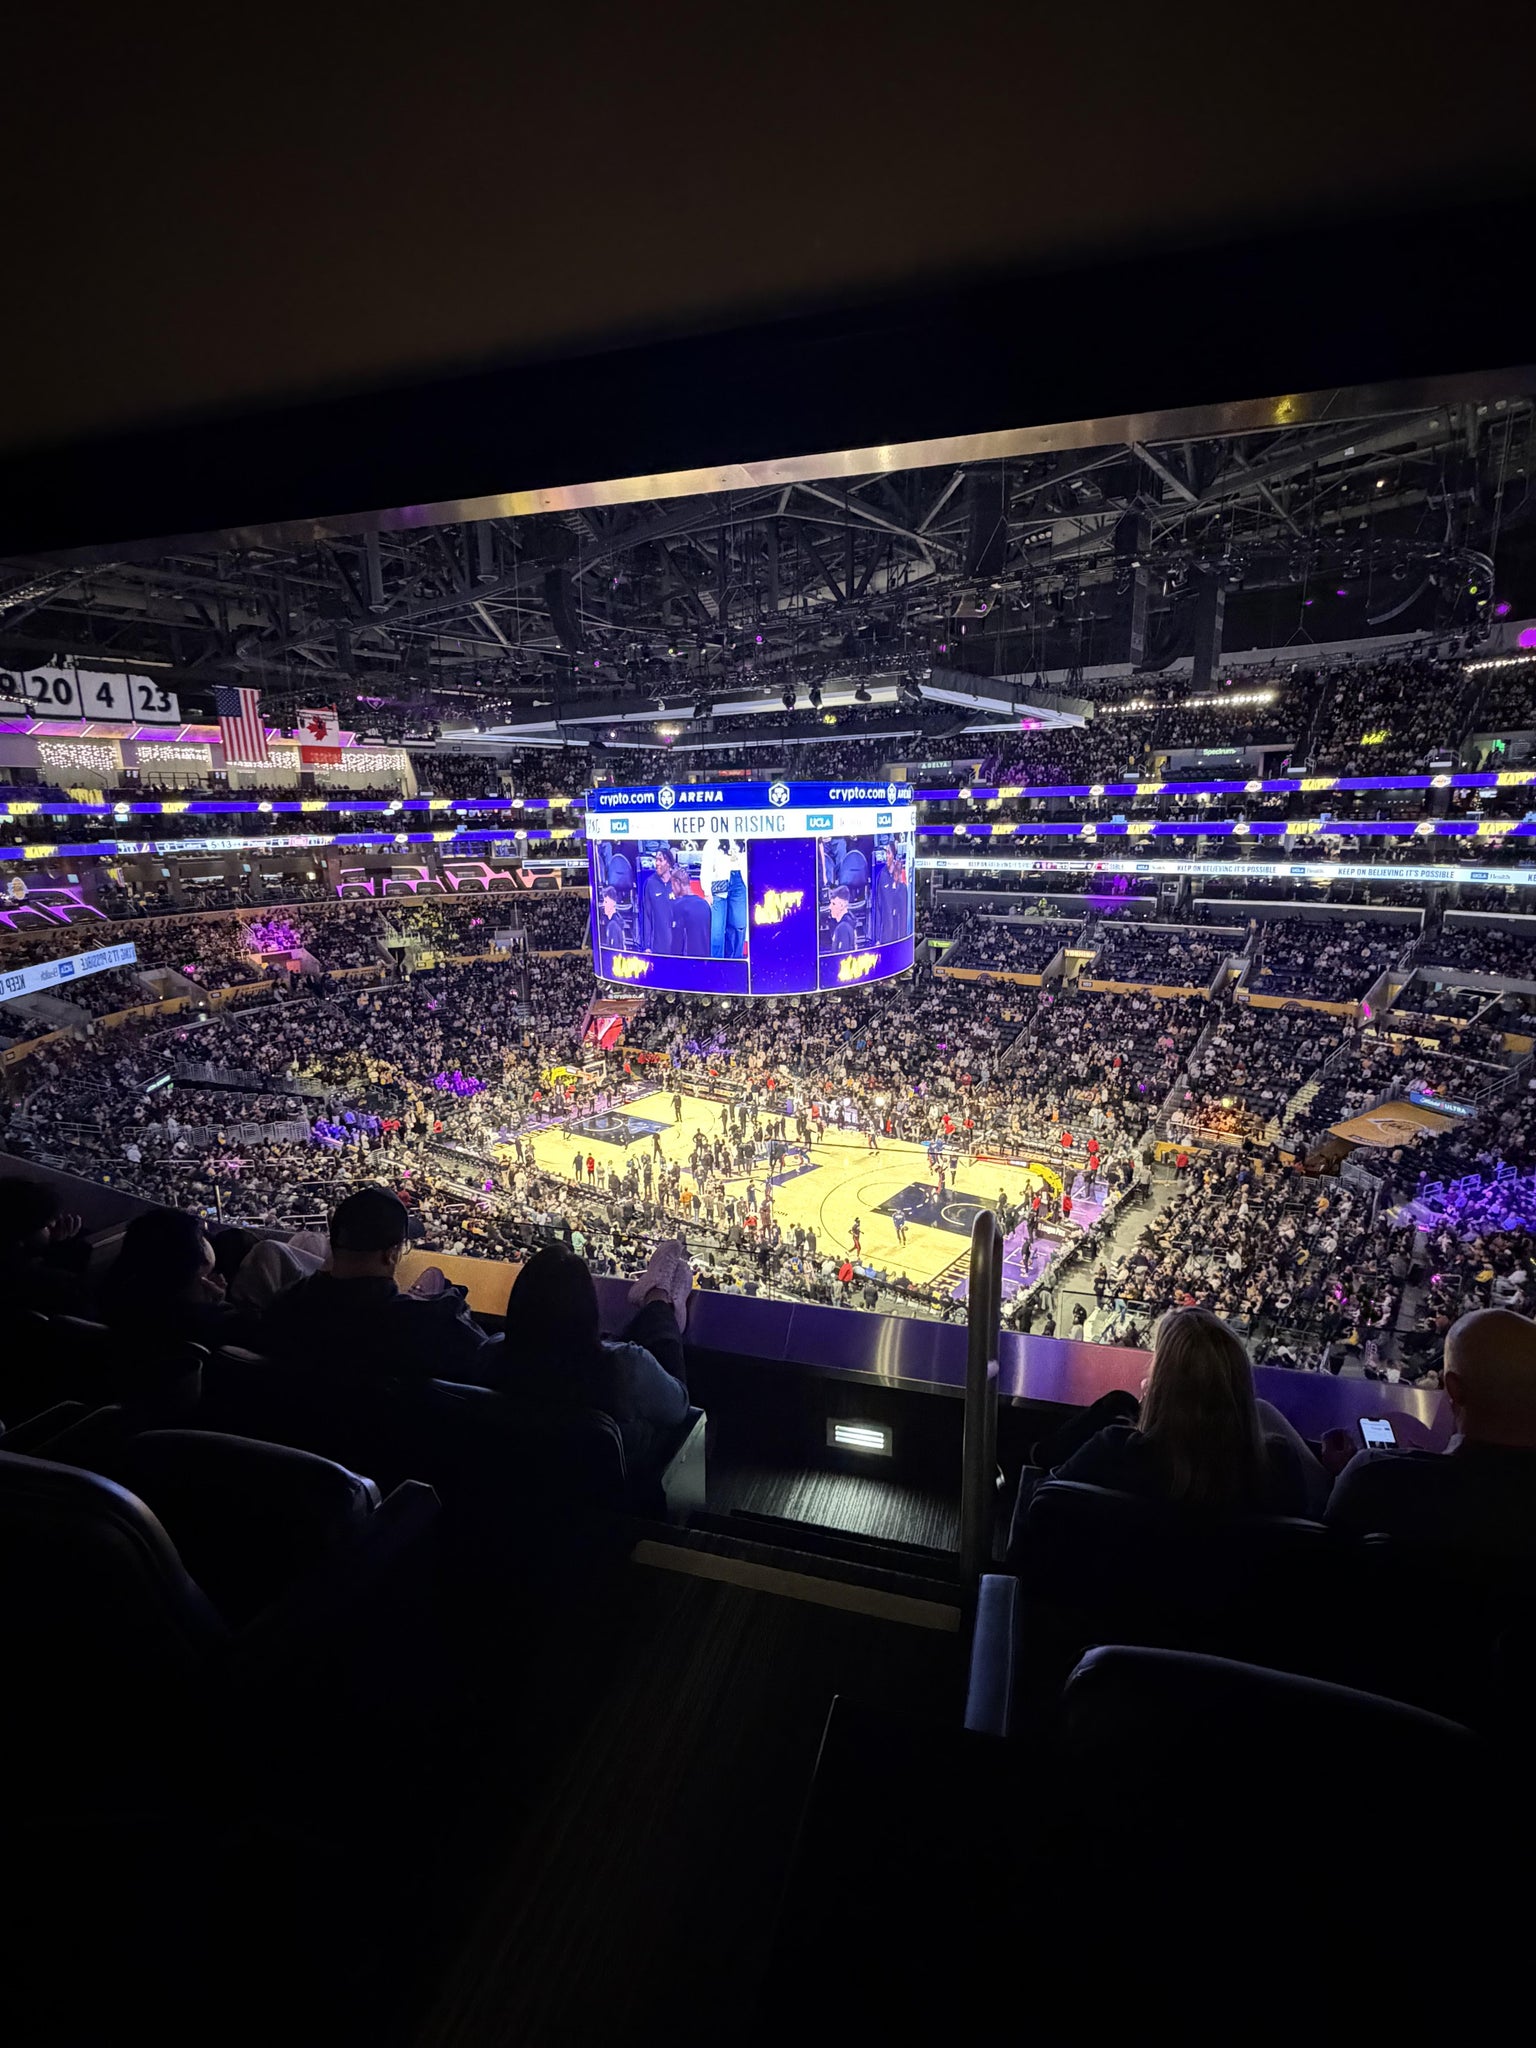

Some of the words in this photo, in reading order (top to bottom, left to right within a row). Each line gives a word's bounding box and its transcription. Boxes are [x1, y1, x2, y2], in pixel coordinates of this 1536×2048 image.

[32, 676, 73, 705] 20
[96, 682, 114, 708] 4
[138, 685, 172, 712] 23
[600, 792, 655, 807] crypto.com
[679, 791, 723, 803] ARENA
[829, 786, 886, 802] crypto.com
[674, 817, 705, 833] KEEP
[710, 816, 729, 833] ON
[735, 815, 785, 832] RISING
[808, 817, 832, 829] UCLA
[1368, 869, 1404, 877] BELIEVING
[1420, 870, 1454, 878] POSSIBLE
[1445, 1104, 1467, 1115] ULTRA
